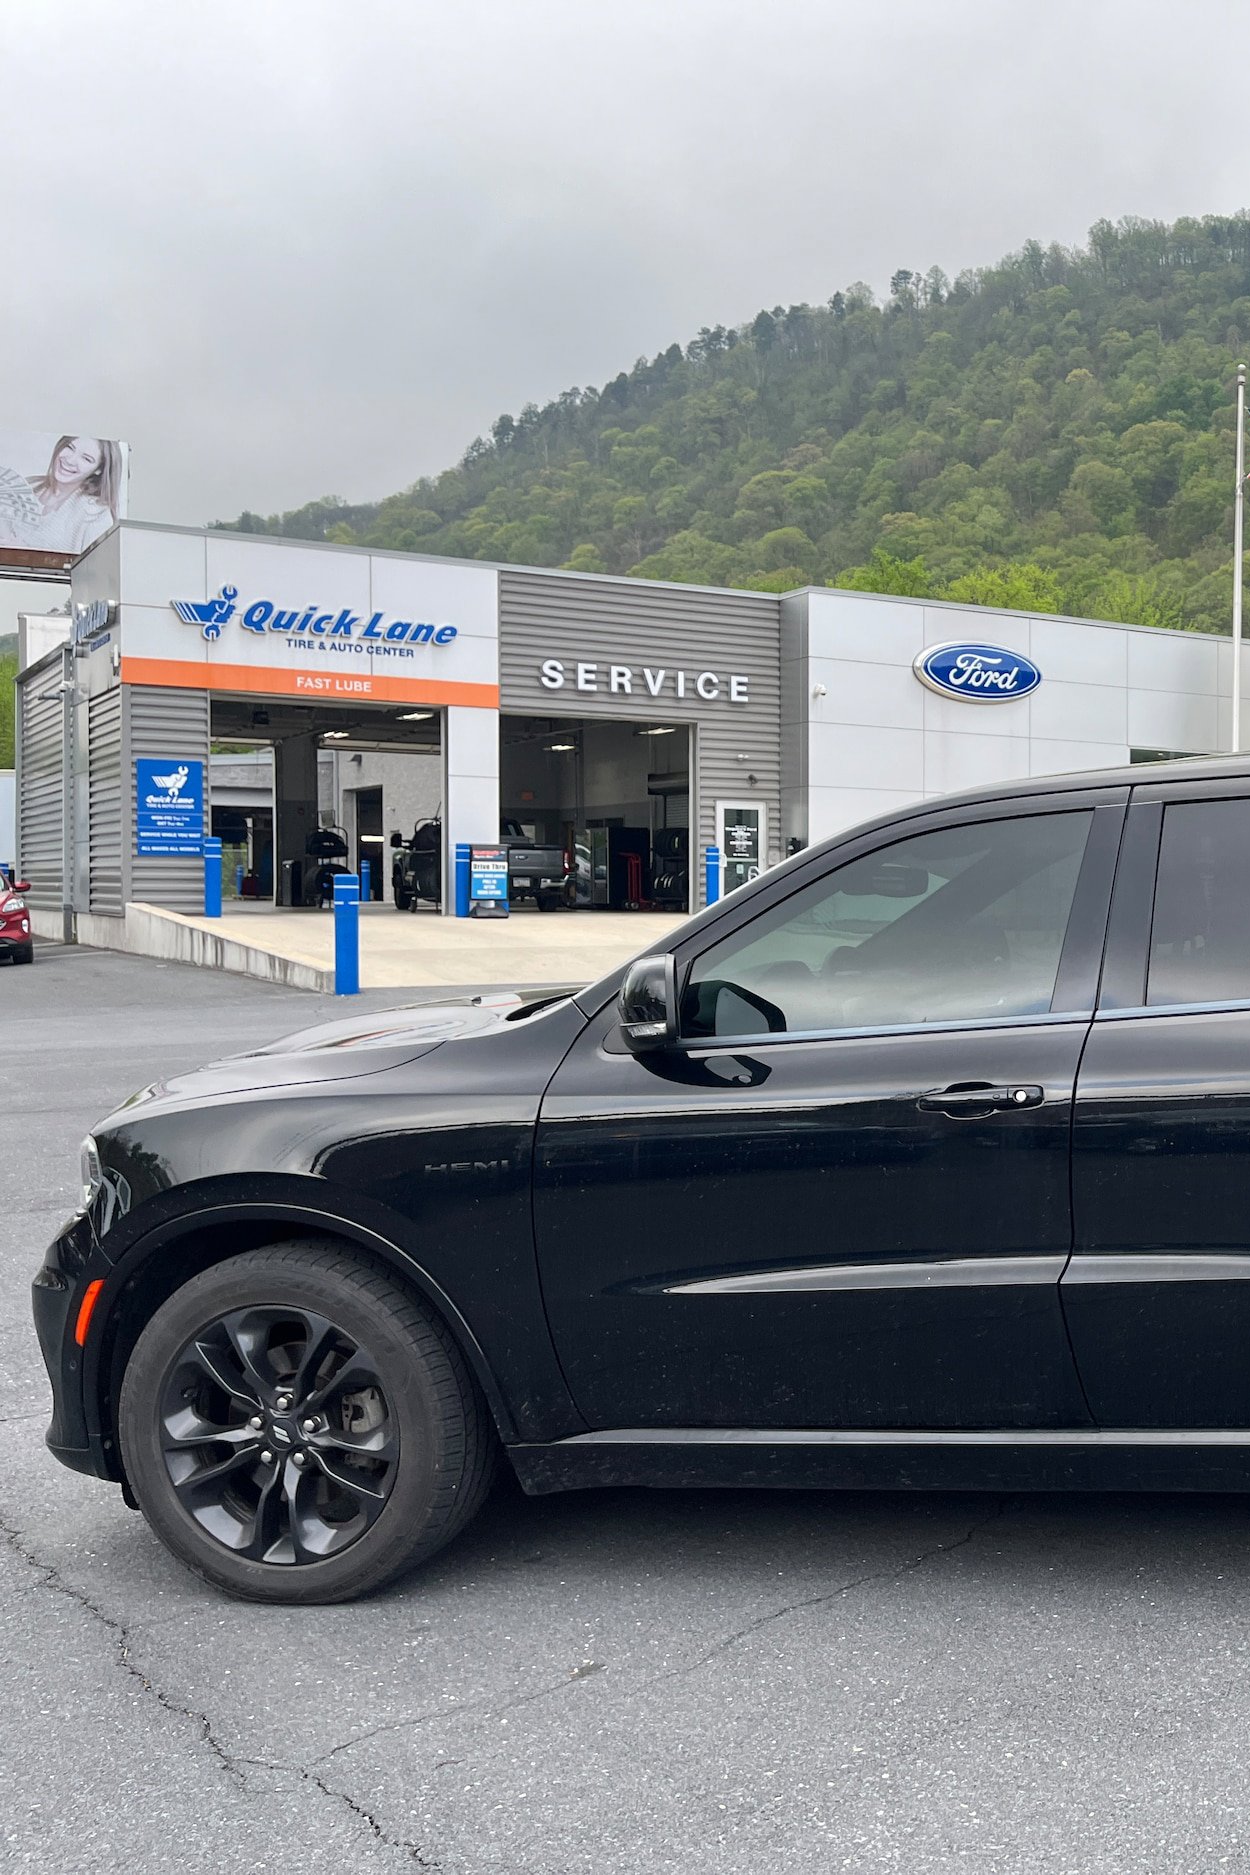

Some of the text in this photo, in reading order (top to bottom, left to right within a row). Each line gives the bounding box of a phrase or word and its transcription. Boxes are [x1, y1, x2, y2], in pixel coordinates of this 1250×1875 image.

[243, 600, 458, 644] Quick Lane
[286, 638, 415, 658] TIRE & AUTO CENTER
[296, 676, 373, 693] FAST LUBE
[541, 659, 750, 702] SERVICE
[948, 653, 1019, 690] Ford
